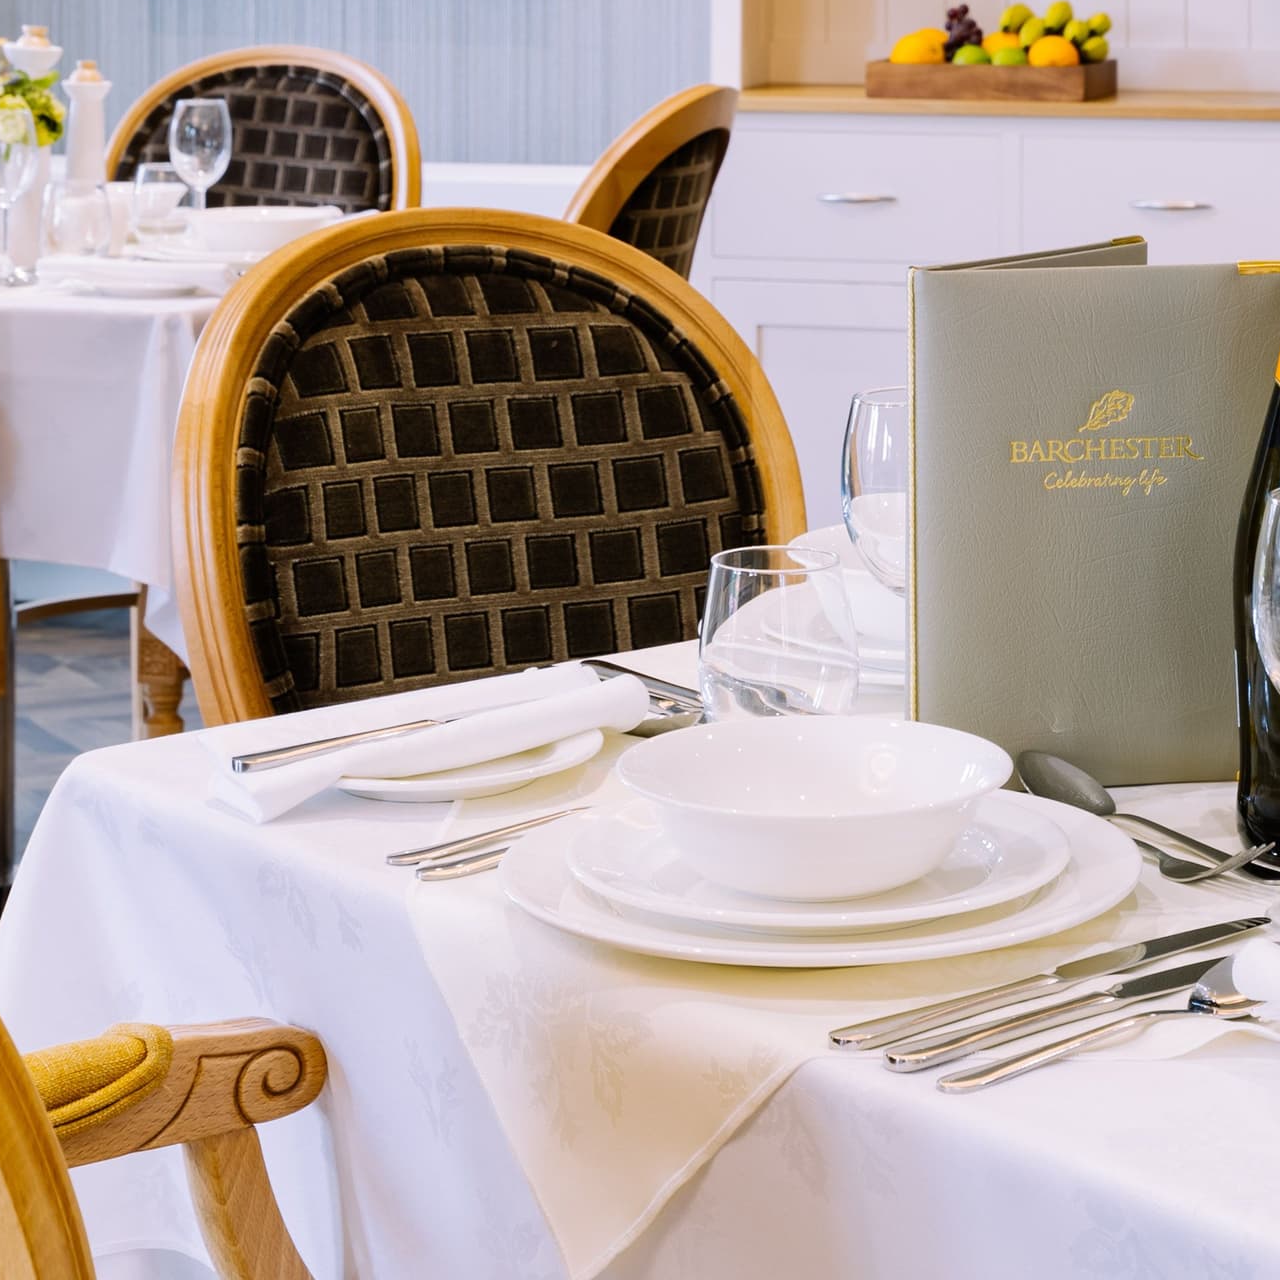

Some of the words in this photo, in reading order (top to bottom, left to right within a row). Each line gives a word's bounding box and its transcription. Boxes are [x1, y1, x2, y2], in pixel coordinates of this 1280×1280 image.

[1009, 436, 1205, 464] BARCHESTER
[1043, 470, 1137, 496] Celebrating
[1138, 469, 1168, 496] life
